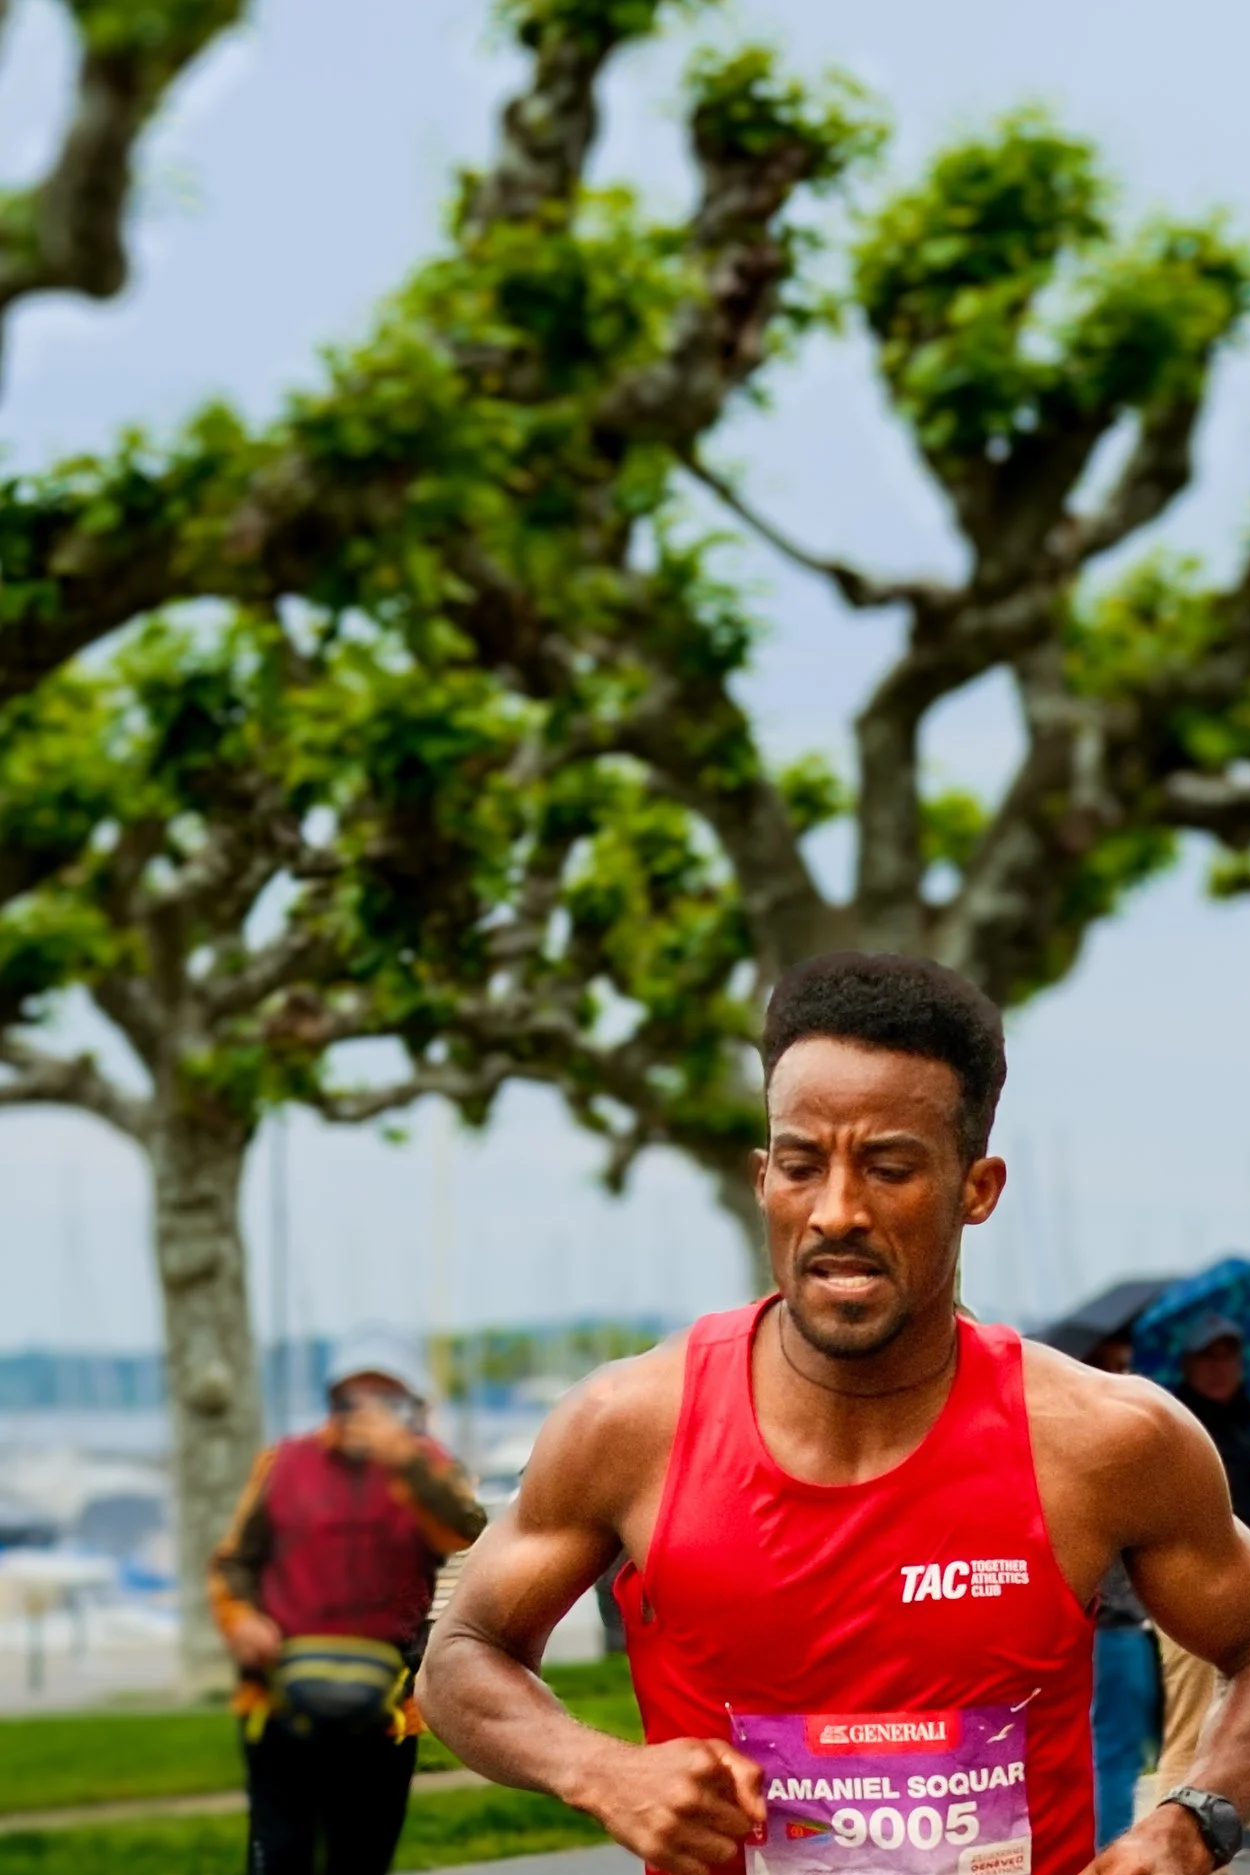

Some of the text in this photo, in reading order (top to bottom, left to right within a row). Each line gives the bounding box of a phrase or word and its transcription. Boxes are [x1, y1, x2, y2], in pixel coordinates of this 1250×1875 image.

[970, 1560, 1027, 1572] TOGETHER
[900, 1561, 969, 1603] TAC
[971, 1572, 1029, 1585] ATHLETICS
[971, 1584, 1001, 1597] CLUB
[849, 1721, 946, 1743] GENERALI
[767, 1761, 1025, 1800] AMANIEL SOQUAR
[831, 1801, 979, 1849] 9005
